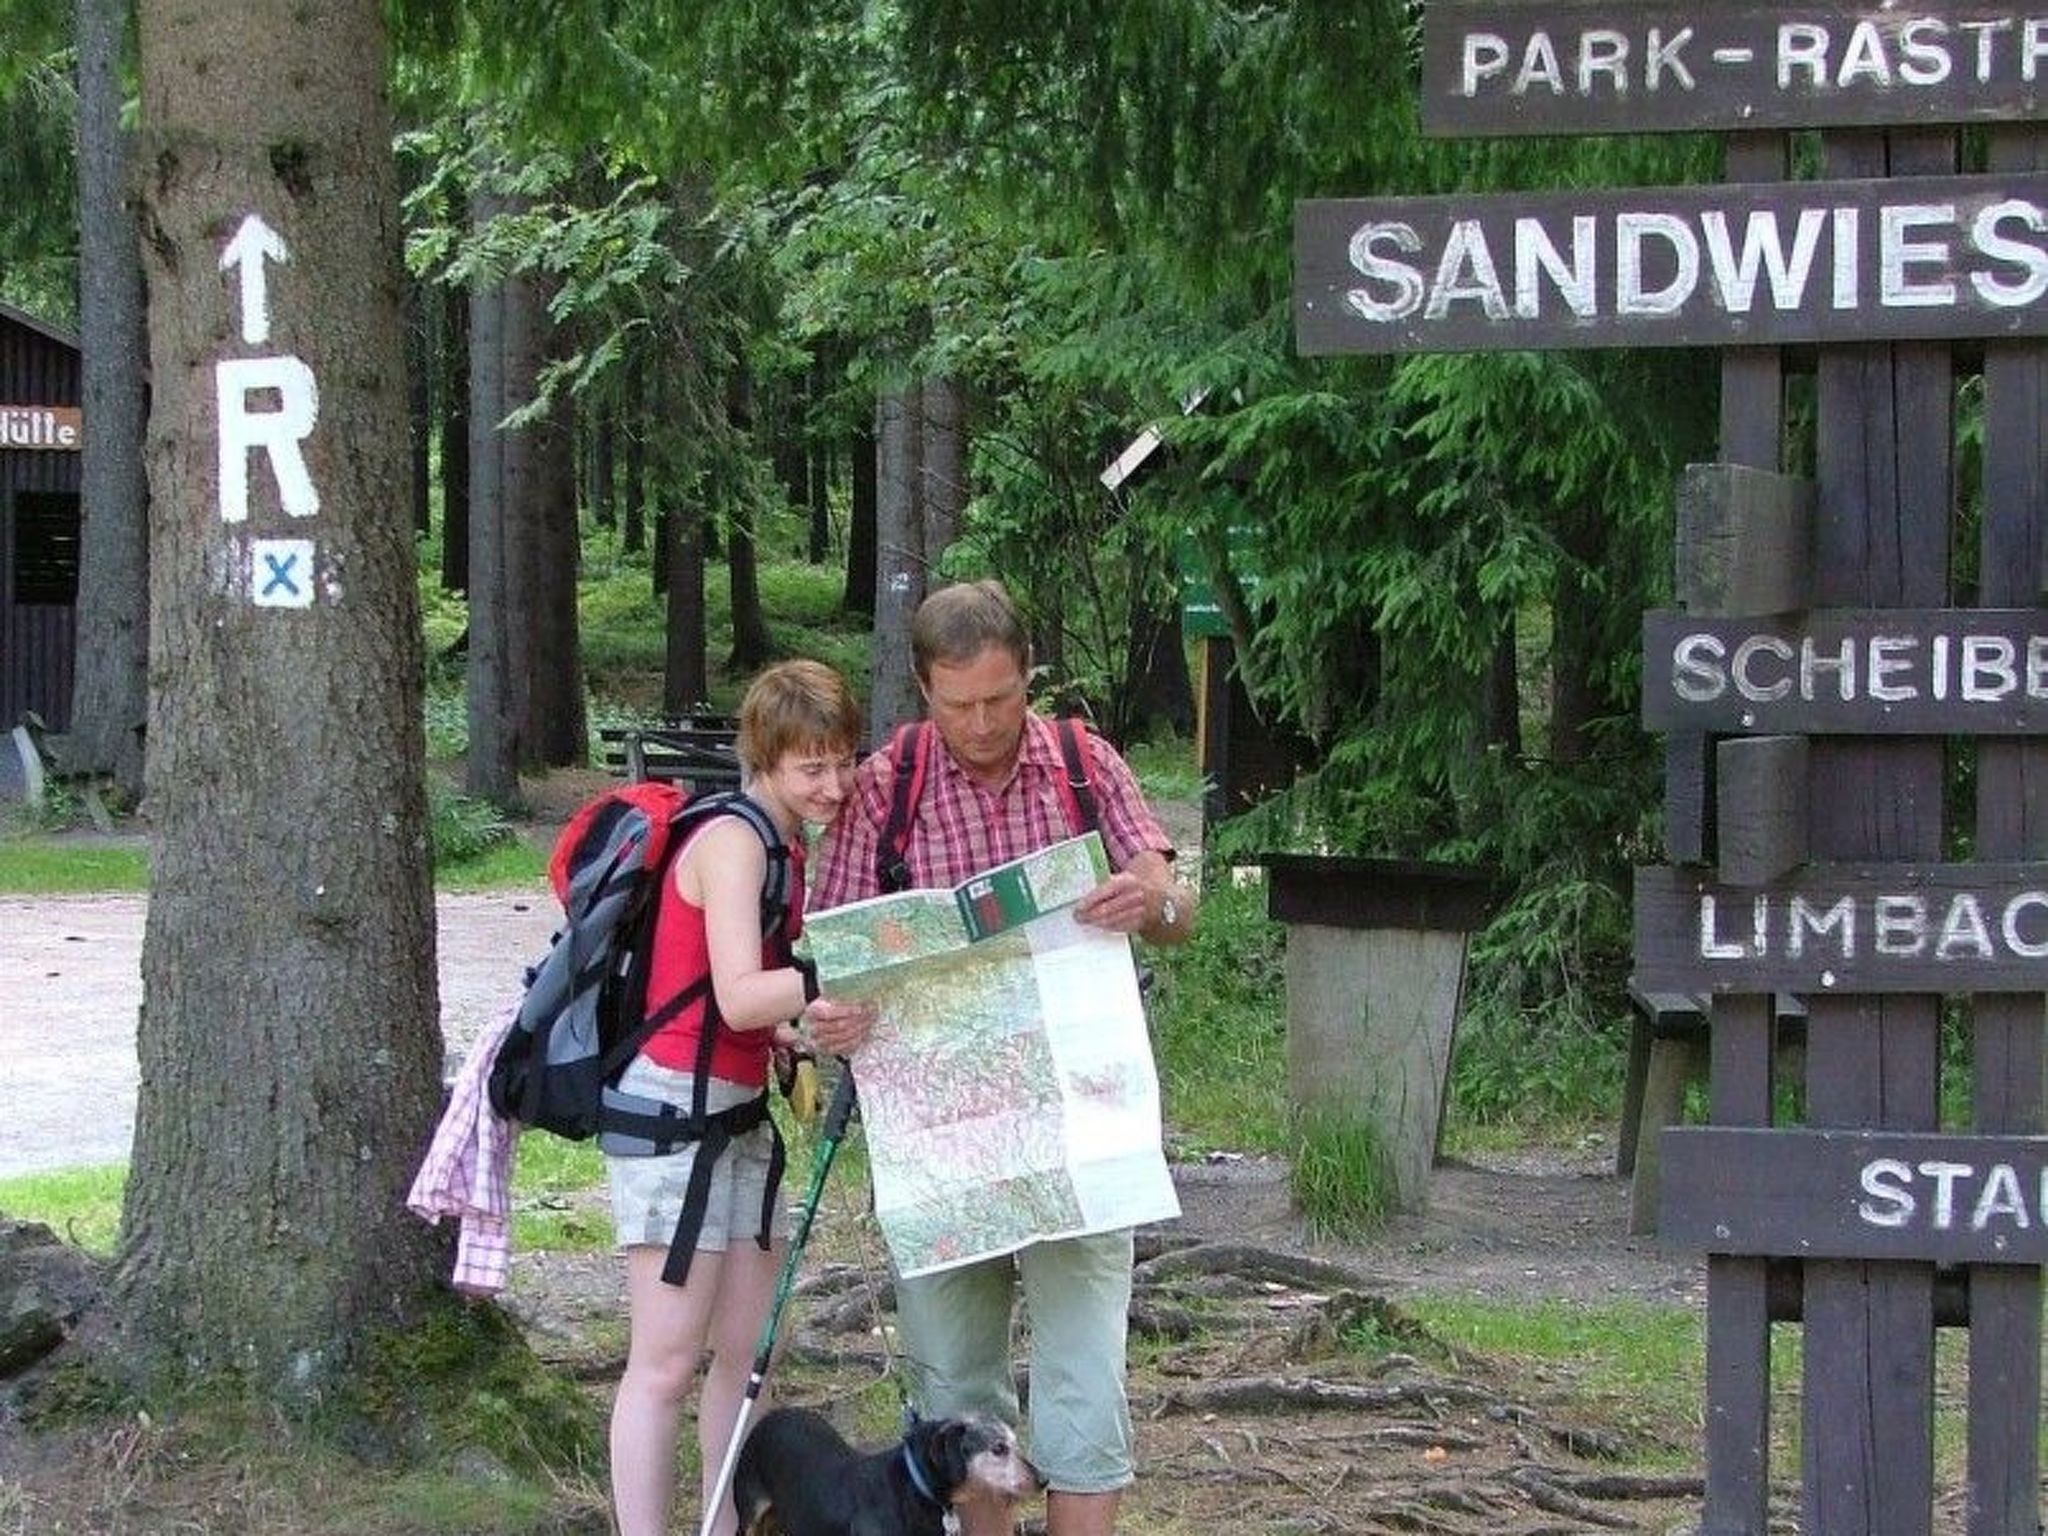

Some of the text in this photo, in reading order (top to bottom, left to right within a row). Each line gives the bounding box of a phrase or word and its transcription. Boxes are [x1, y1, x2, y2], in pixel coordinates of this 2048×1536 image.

[1345, 199, 2048, 322] SANDWIES
[215, 355, 320, 523] R
[1701, 891, 2048, 959] LIMBAC
[1858, 1158, 2048, 1230] STA
